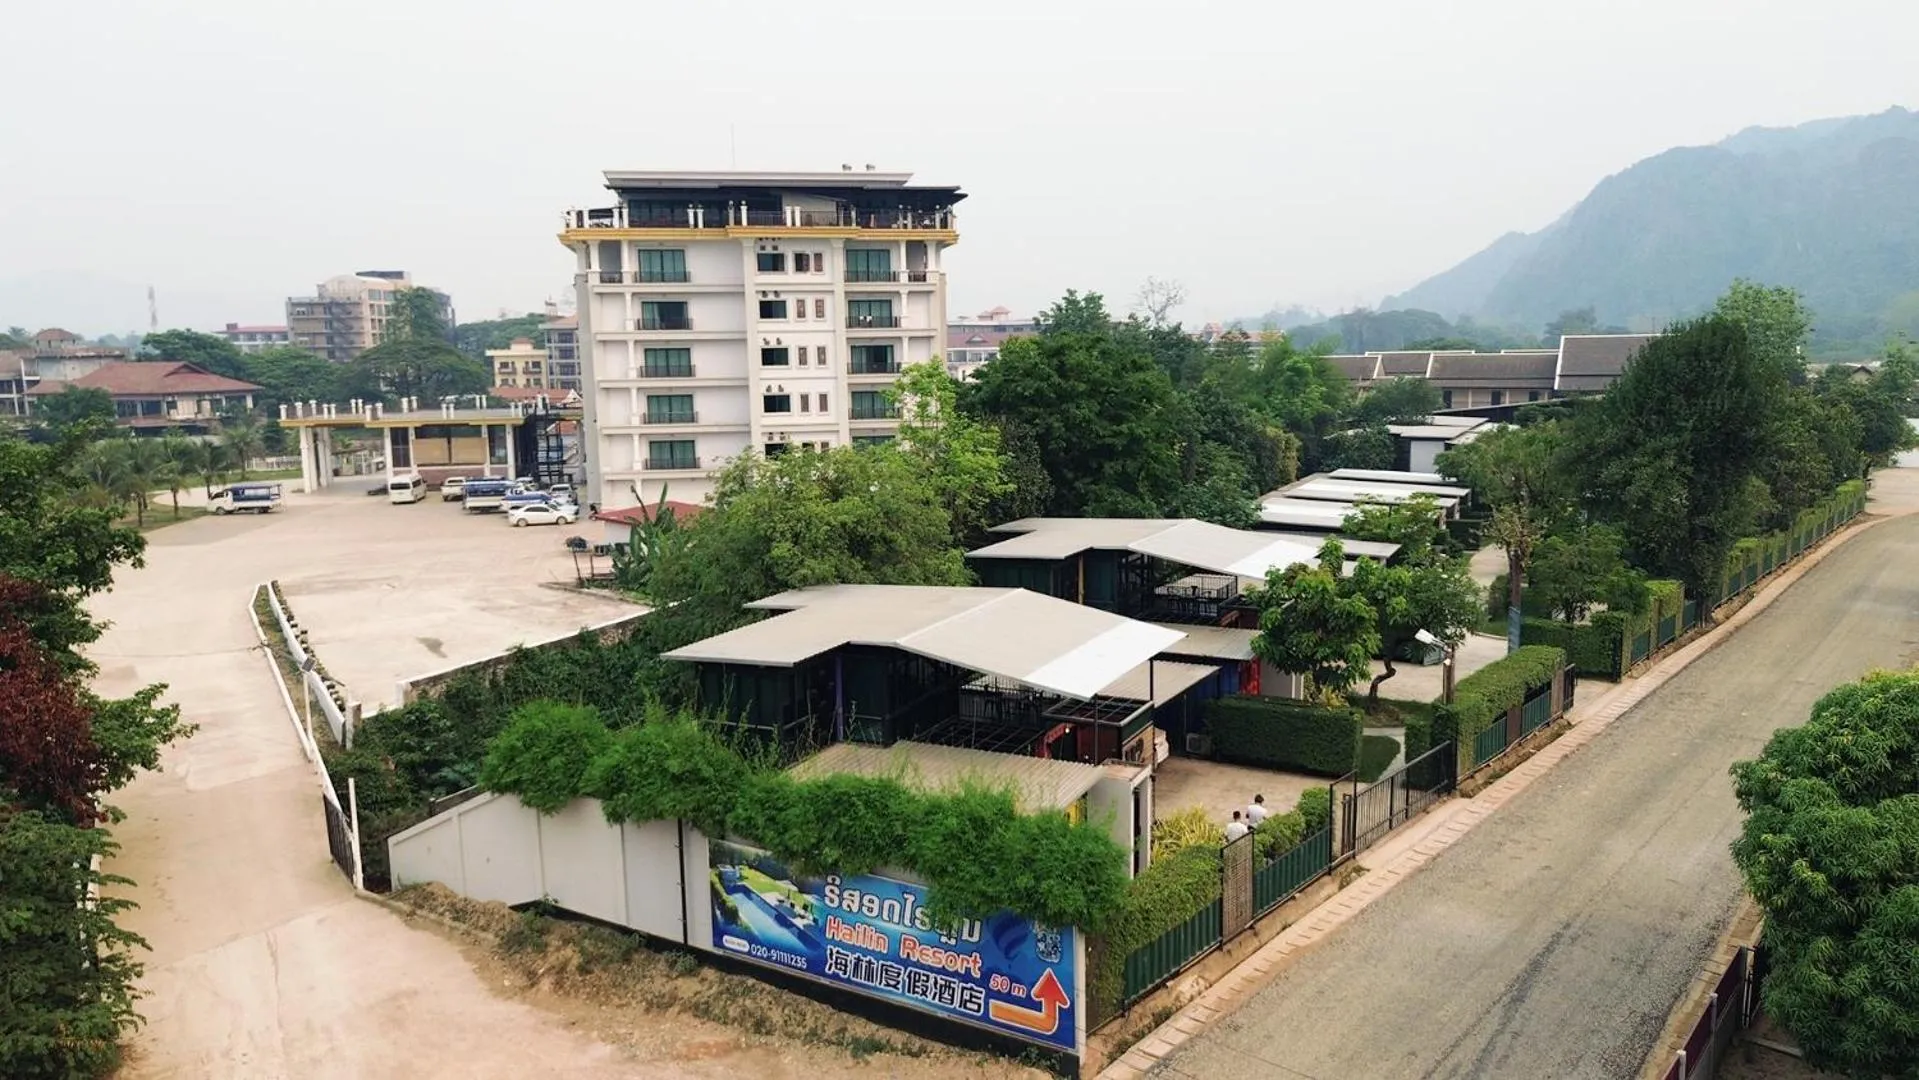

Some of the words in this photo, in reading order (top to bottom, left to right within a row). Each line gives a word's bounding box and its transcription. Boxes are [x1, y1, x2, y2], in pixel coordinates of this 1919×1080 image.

[826, 915, 888, 953] Hailin
[901, 934, 981, 977] Resort
[825, 945, 985, 1015] 海林度假酒店
[989, 973, 1010, 993] 50
[1011, 984, 1027, 998] m
